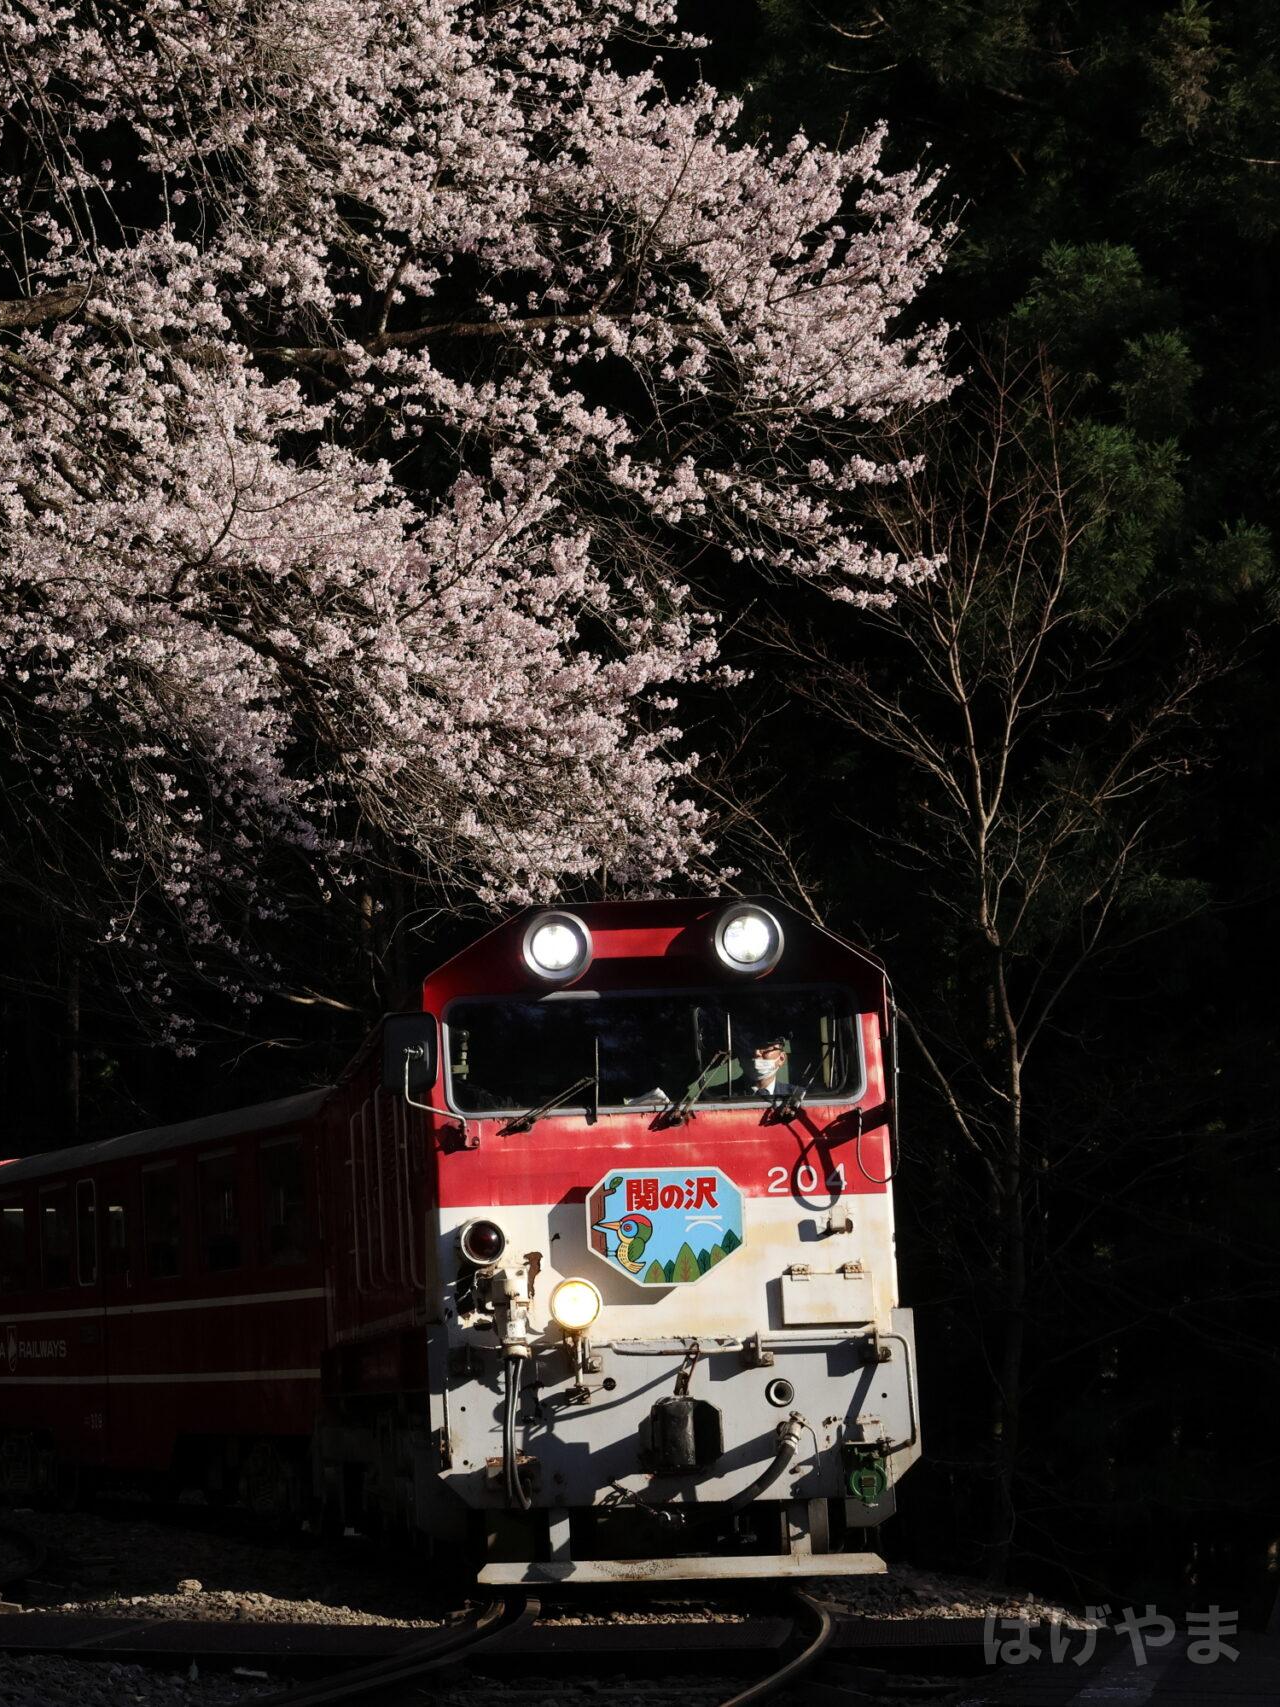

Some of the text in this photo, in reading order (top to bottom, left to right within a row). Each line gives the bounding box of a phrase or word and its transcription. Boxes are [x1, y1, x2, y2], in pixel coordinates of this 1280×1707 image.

[768, 1163, 847, 1193] 204
[626, 1177, 718, 1212] 関の沢
[18, 1339, 67, 1358] RAILWAYS
